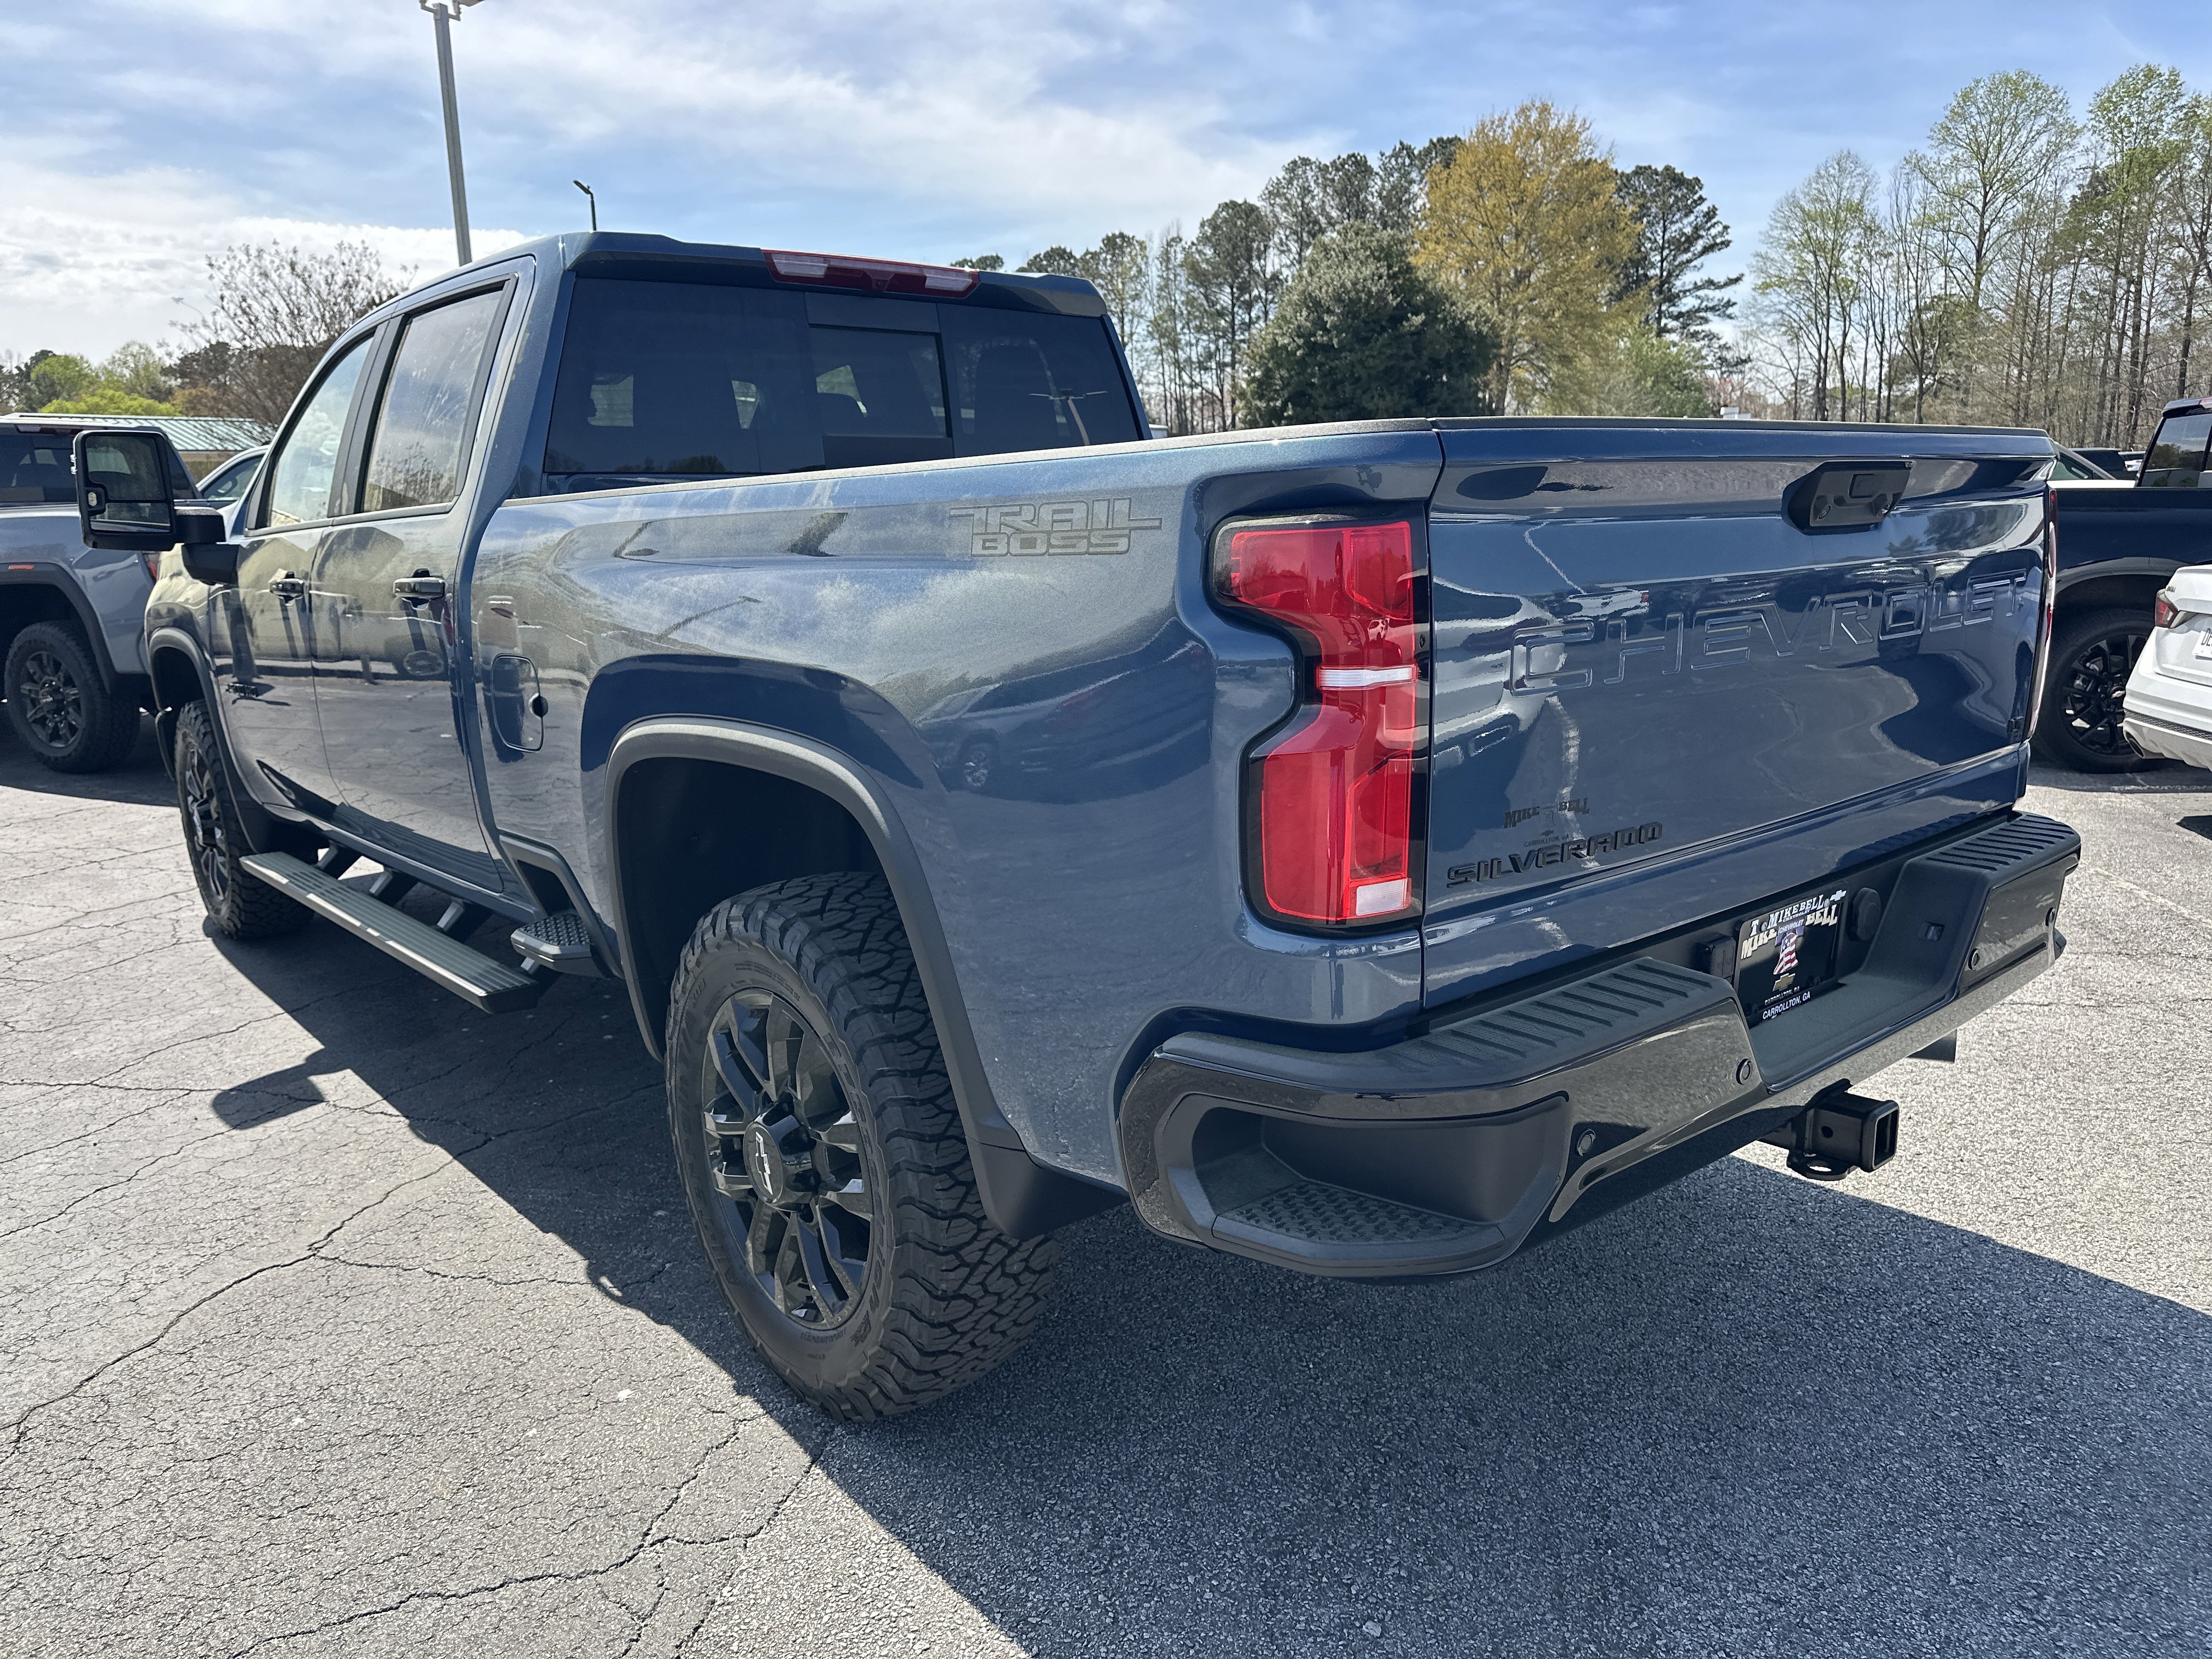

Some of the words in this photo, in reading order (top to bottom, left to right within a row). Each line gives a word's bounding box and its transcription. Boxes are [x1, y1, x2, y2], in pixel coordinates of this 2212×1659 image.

[949, 496, 1161, 534] TRAIL
[971, 529, 1130, 557] BOSS
[1510, 569, 2026, 697] CHEVROLET
[1503, 806, 1540, 828] MIKE
[1558, 797, 1590, 815] BELL
[1447, 821, 1663, 888] SILVERADO
[1779, 919, 1804, 933] CHEVROLET
[1782, 909, 1811, 922] CHEVROLET
[1805, 905, 1837, 927] BELL
[1741, 928, 1777, 960] MIKE
[1763, 995, 1802, 1020] CARROLLTON,
[1802, 991, 1810, 1001] GA
